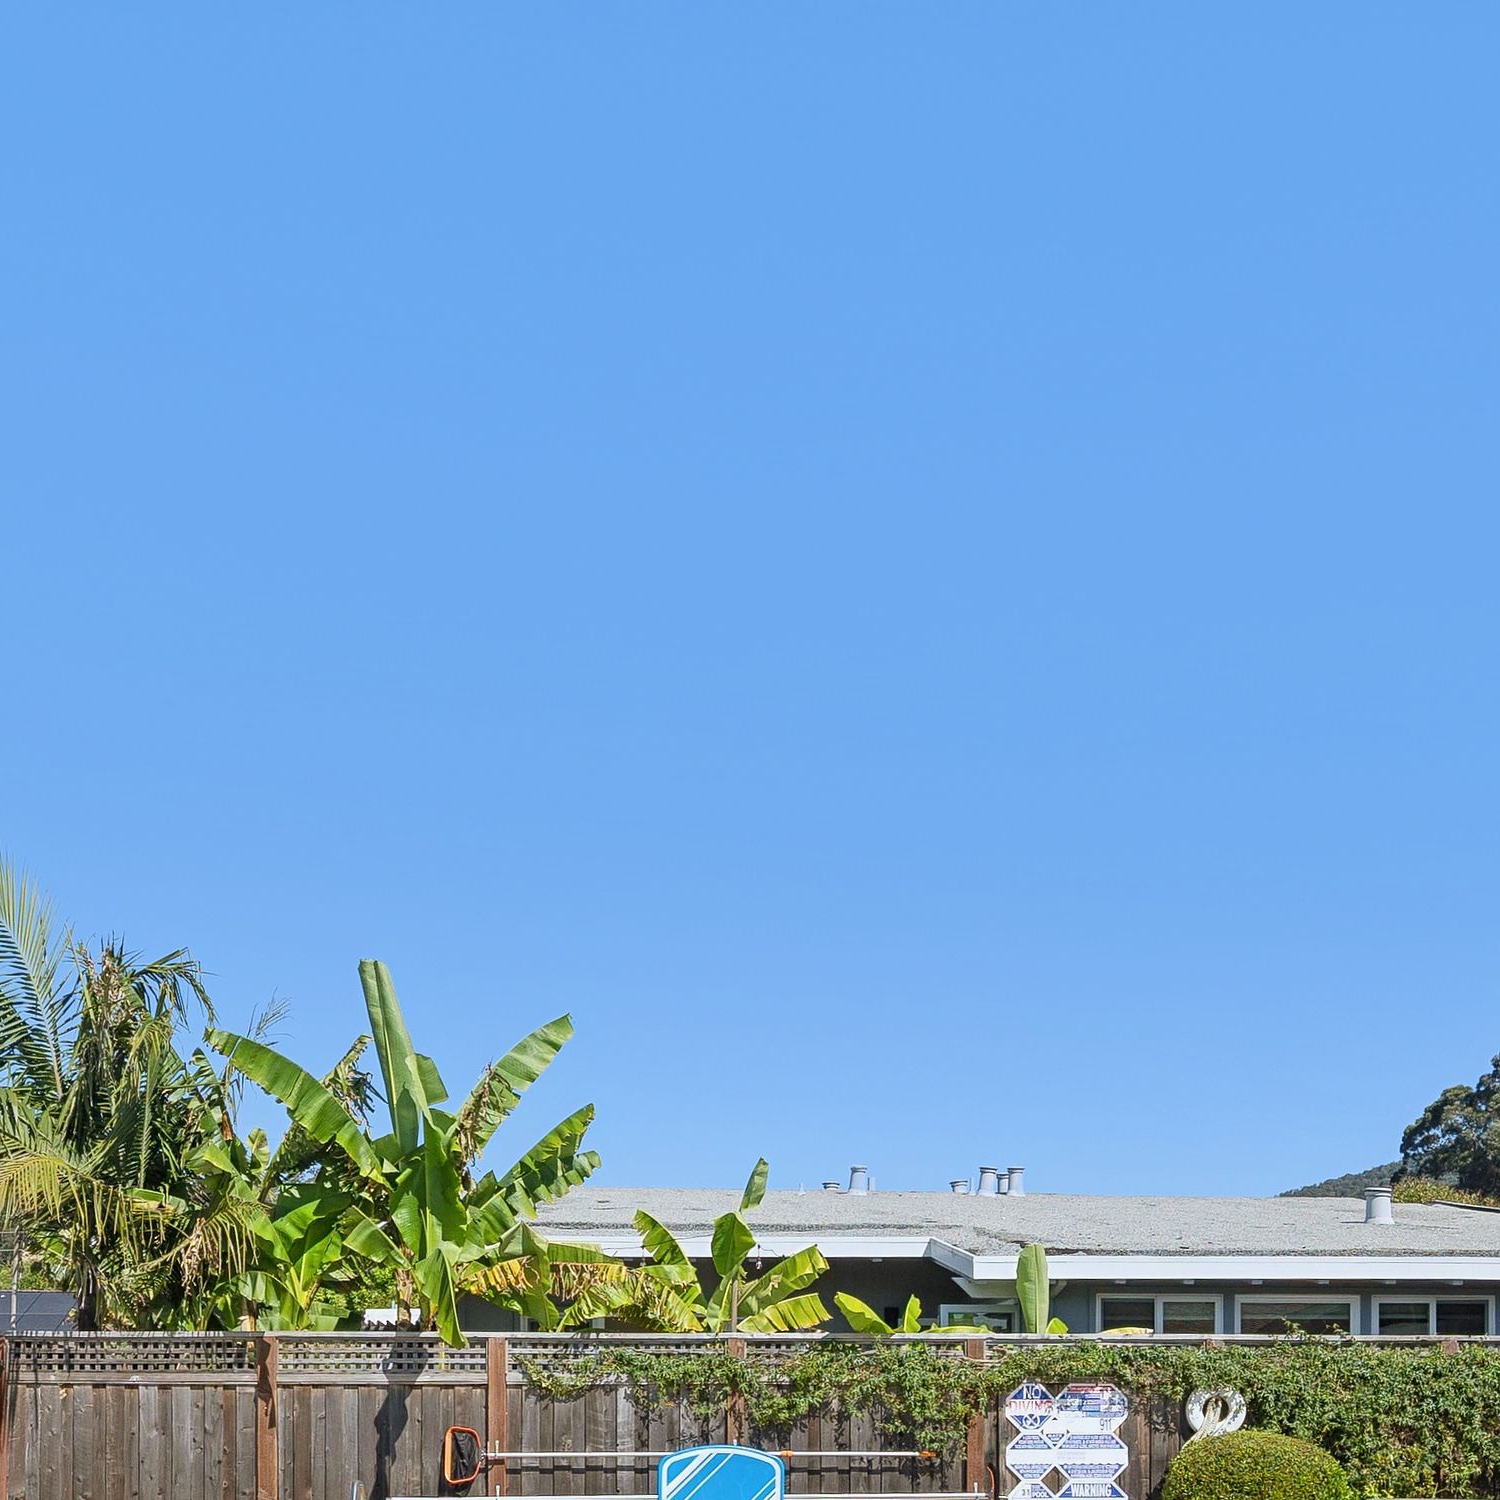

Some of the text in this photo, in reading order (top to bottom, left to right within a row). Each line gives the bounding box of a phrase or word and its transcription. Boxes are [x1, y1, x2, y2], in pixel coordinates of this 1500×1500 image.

[1023, 1385, 1041, 1399] NO
[1009, 1400, 1053, 1412] DIVING
[1100, 1418, 1112, 1431] 911
[1071, 1483, 1112, 1497] WARNING
